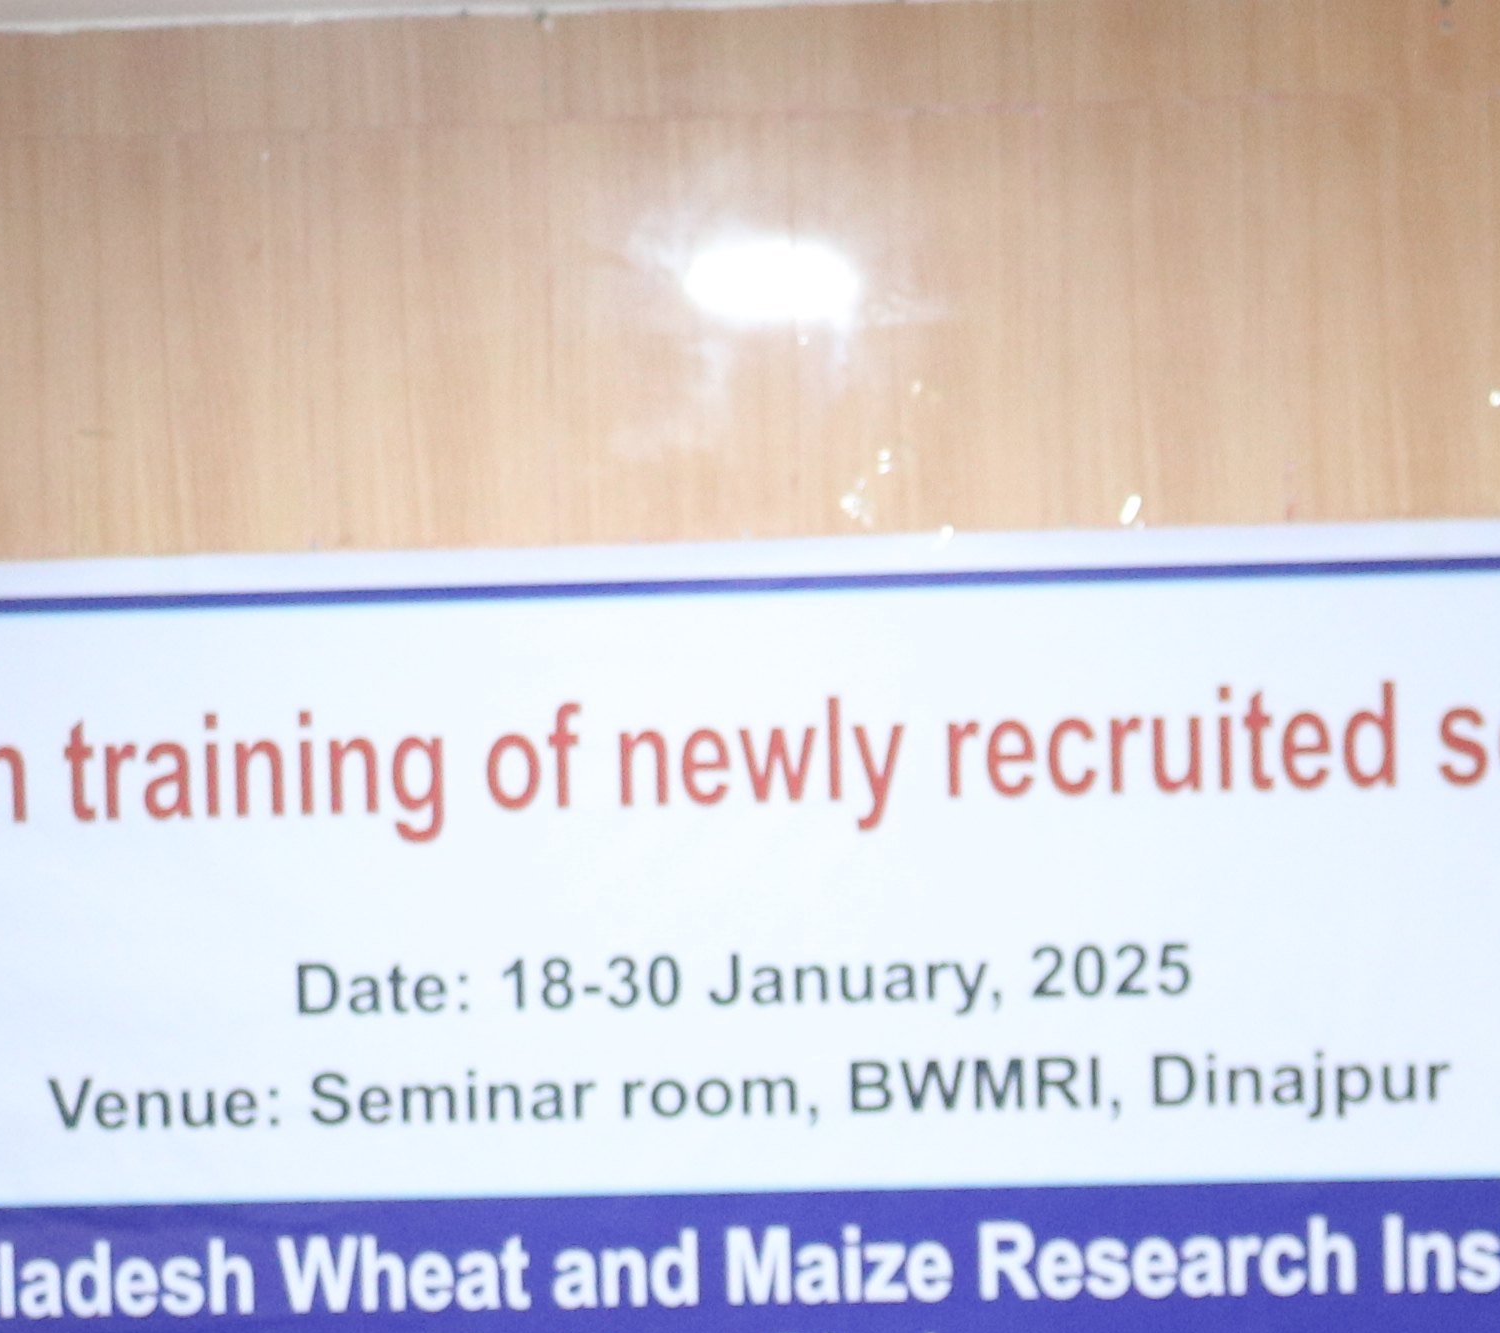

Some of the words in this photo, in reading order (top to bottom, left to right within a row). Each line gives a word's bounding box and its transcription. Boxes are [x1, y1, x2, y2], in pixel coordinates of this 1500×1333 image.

[64, 710, 444, 844] training
[487, 702, 581, 811] of
[619, 696, 904, 831] newly
[947, 680, 1397, 798] recruited
[297, 962, 473, 1016] Date:
[501, 955, 682, 1010] 18-30
[709, 953, 1002, 1016] January,
[1032, 943, 1192, 999] 2025
[48, 1077, 281, 1131] Venue:
[311, 1071, 596, 1126] Seminar
[622, 1077, 820, 1124] room,
[849, 1056, 1122, 1116] BWMRI,
[1153, 1053, 1450, 1119] Dinajpur
[277, 1234, 532, 1314] Wheat
[552, 1228, 699, 1310] and
[725, 1224, 954, 1306] Maize
[978, 1215, 1357, 1301] Research
